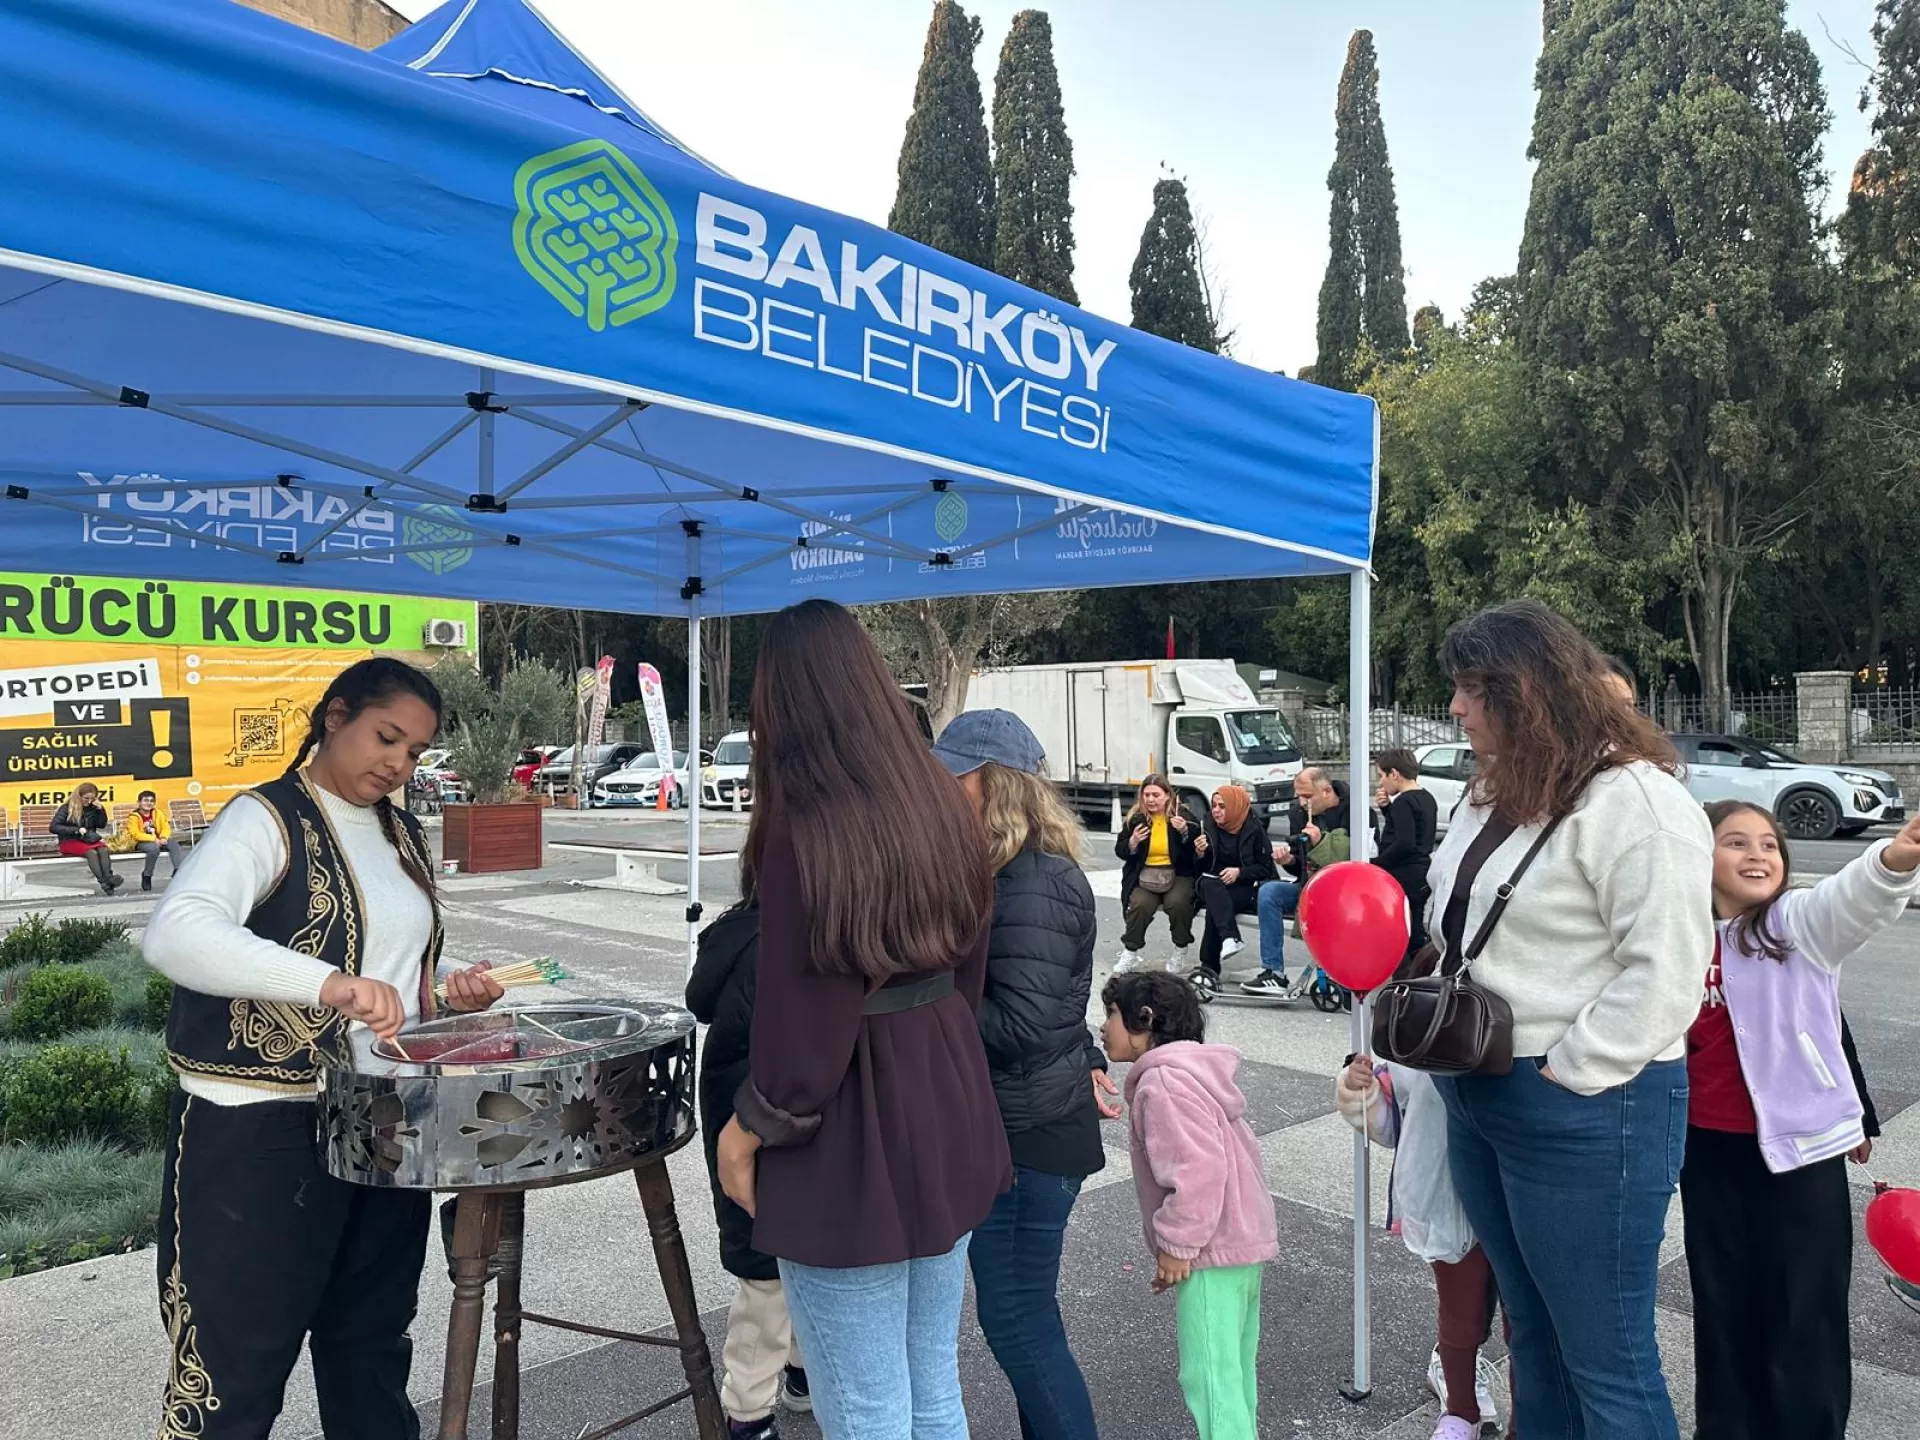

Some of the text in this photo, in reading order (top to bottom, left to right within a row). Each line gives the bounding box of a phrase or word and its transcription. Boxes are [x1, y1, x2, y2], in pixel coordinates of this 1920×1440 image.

[696, 192, 1118, 392] BAKIRKÖY
[694, 277, 1111, 453] BELEDİYESİ
[0, 576, 391, 645] RÜCÜ KURSU
[0, 663, 148, 699] RTOPEDİ
[70, 704, 105, 721] VE
[22, 732, 98, 750] SAĞLIK
[8, 751, 113, 772] ÜRÜNLERİ
[20, 786, 114, 805] MERZİ
